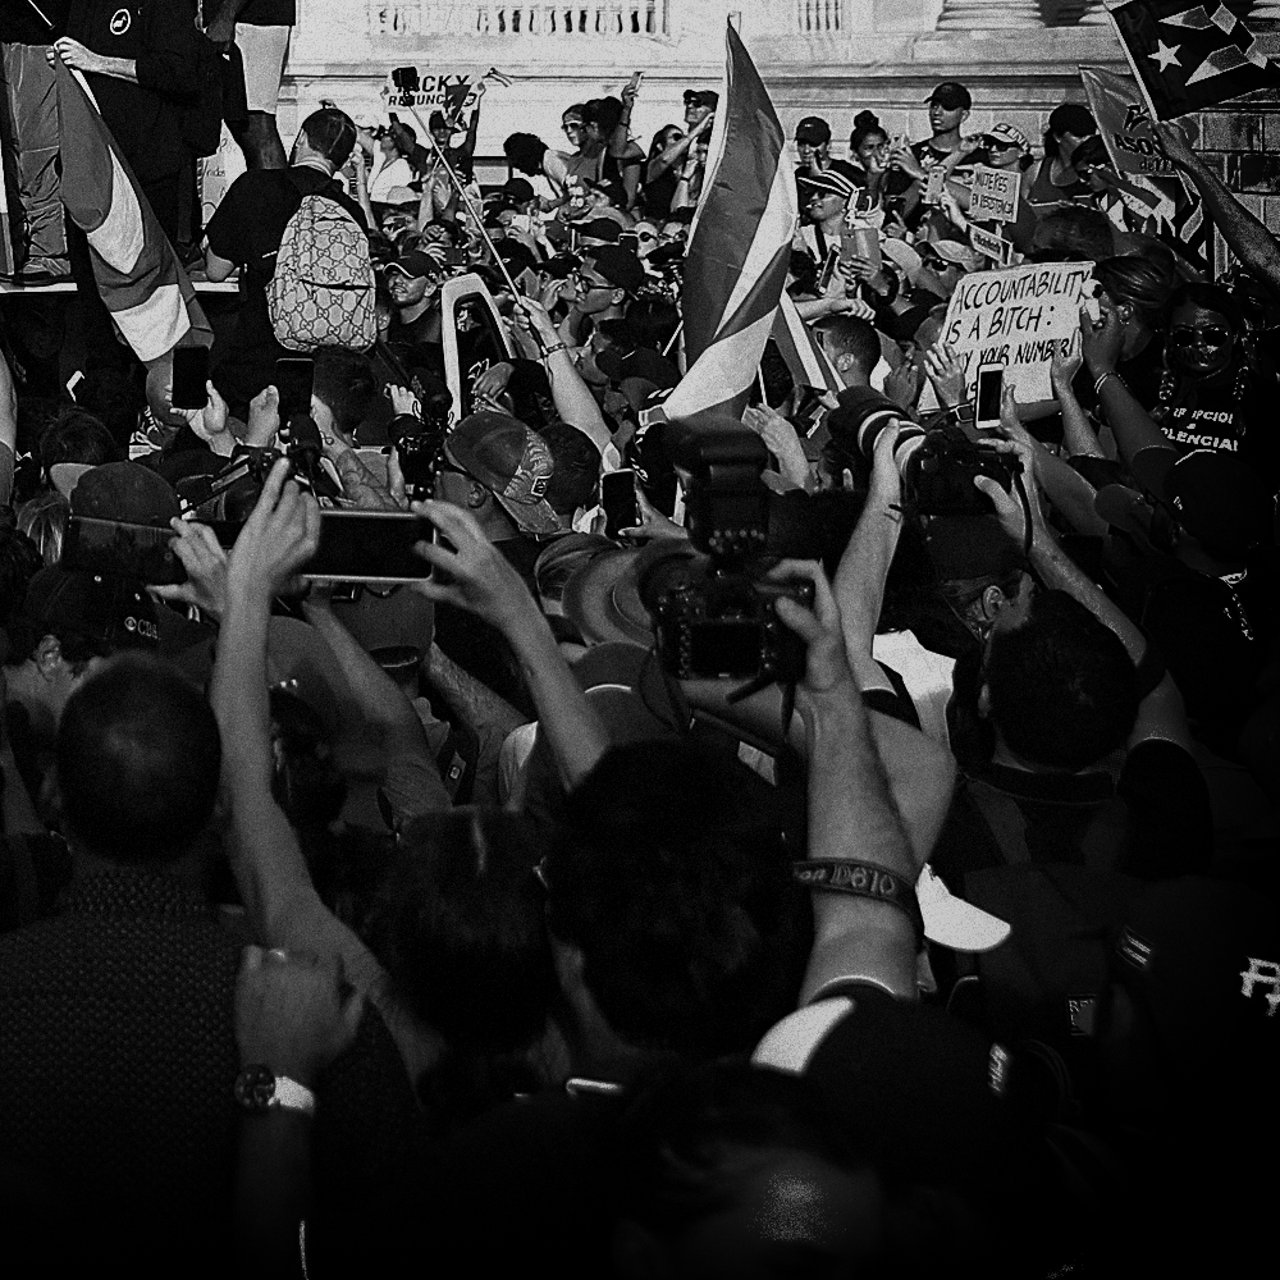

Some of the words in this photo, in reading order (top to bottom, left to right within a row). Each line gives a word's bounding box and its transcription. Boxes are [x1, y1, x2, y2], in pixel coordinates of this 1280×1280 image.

[953, 271, 1090, 314] ACCOUNTABILITY
[945, 320, 962, 344] IS
[968, 315, 980, 341] A
